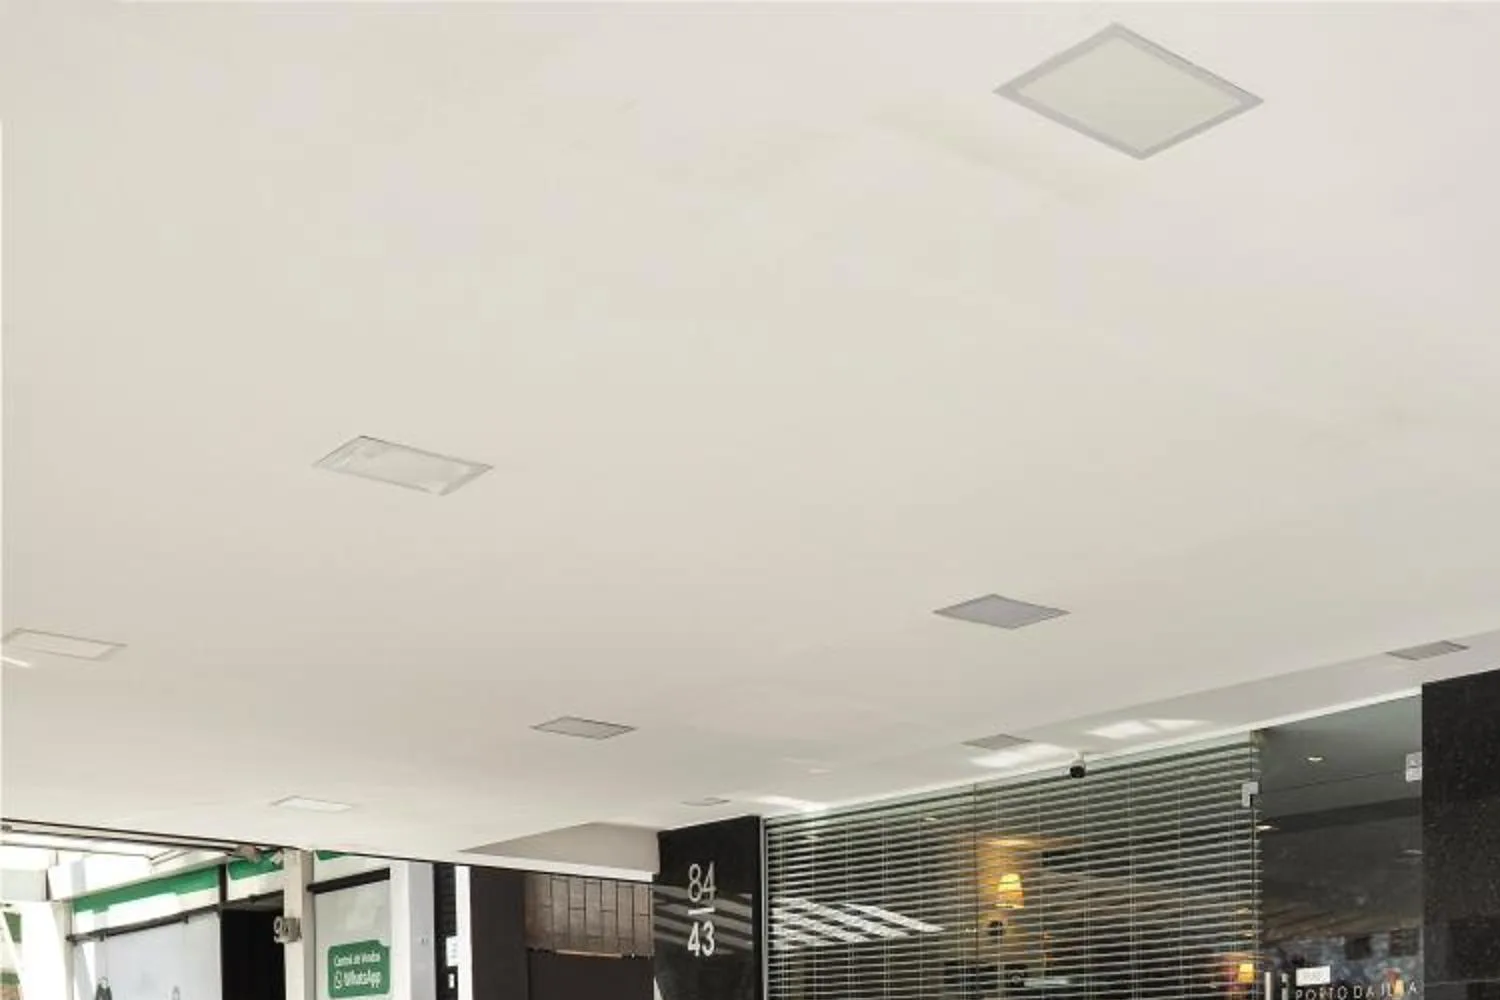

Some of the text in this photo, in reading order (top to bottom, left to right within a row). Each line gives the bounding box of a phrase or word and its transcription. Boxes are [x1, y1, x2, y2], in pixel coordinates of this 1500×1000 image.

[688, 861, 716, 902] 84
[687, 920, 715, 956] 43
[1353, 985, 1376, 1000] DA
[1381, 981, 1417, 998] ILA
